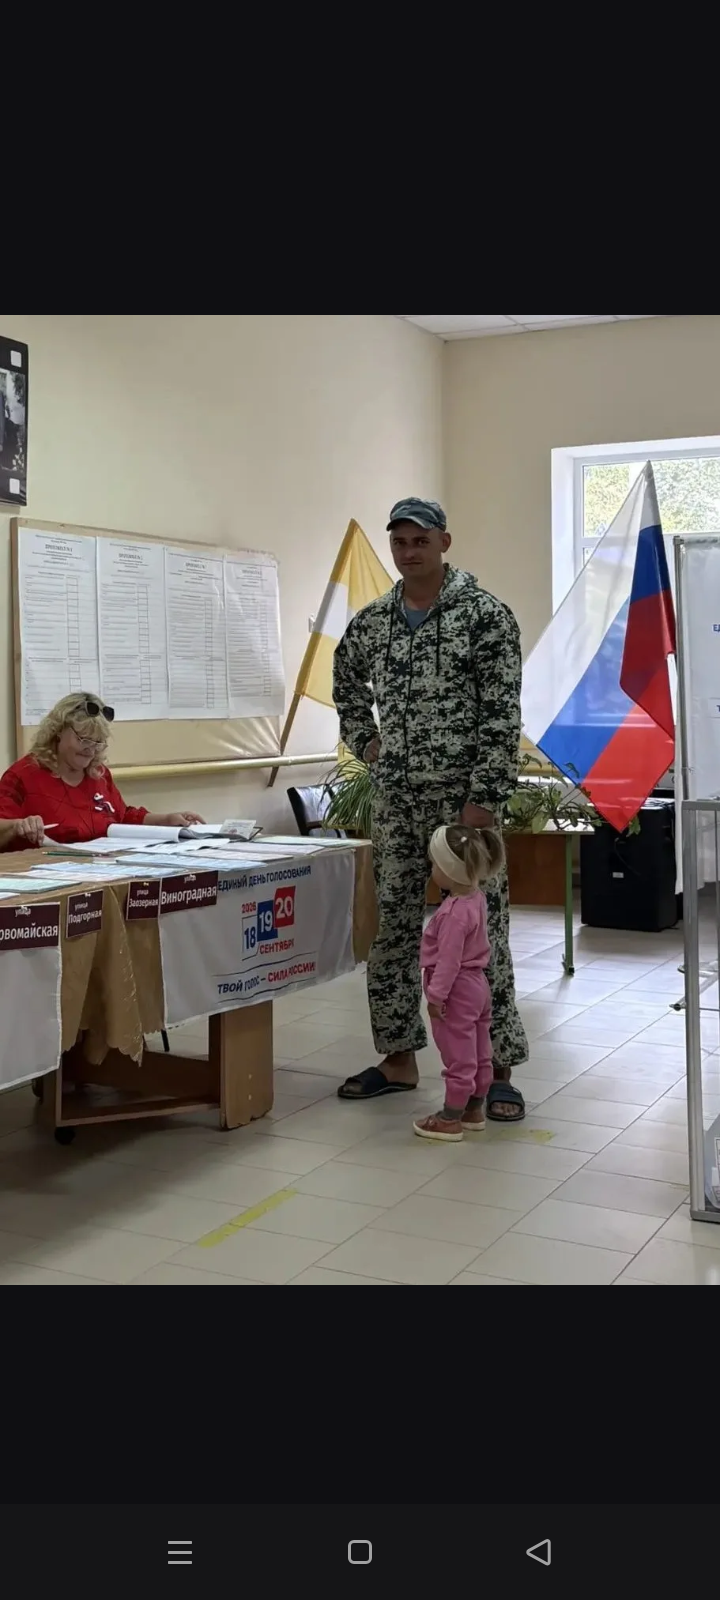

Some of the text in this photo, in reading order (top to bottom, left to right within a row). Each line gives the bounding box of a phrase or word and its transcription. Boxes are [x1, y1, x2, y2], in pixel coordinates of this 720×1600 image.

[218, 865, 311, 891] ЕДИНЫЙ ДЕНЬ ГОЛОСОВАНИЯ
[161, 886, 217, 905] Виноградная
[129, 898, 159, 908] Заозерная
[241, 901, 257, 913] 2026
[68, 910, 102, 924] Подгорная
[244, 896, 293, 950] 18 19 20
[217, 980, 243, 994] ТВОЙ
